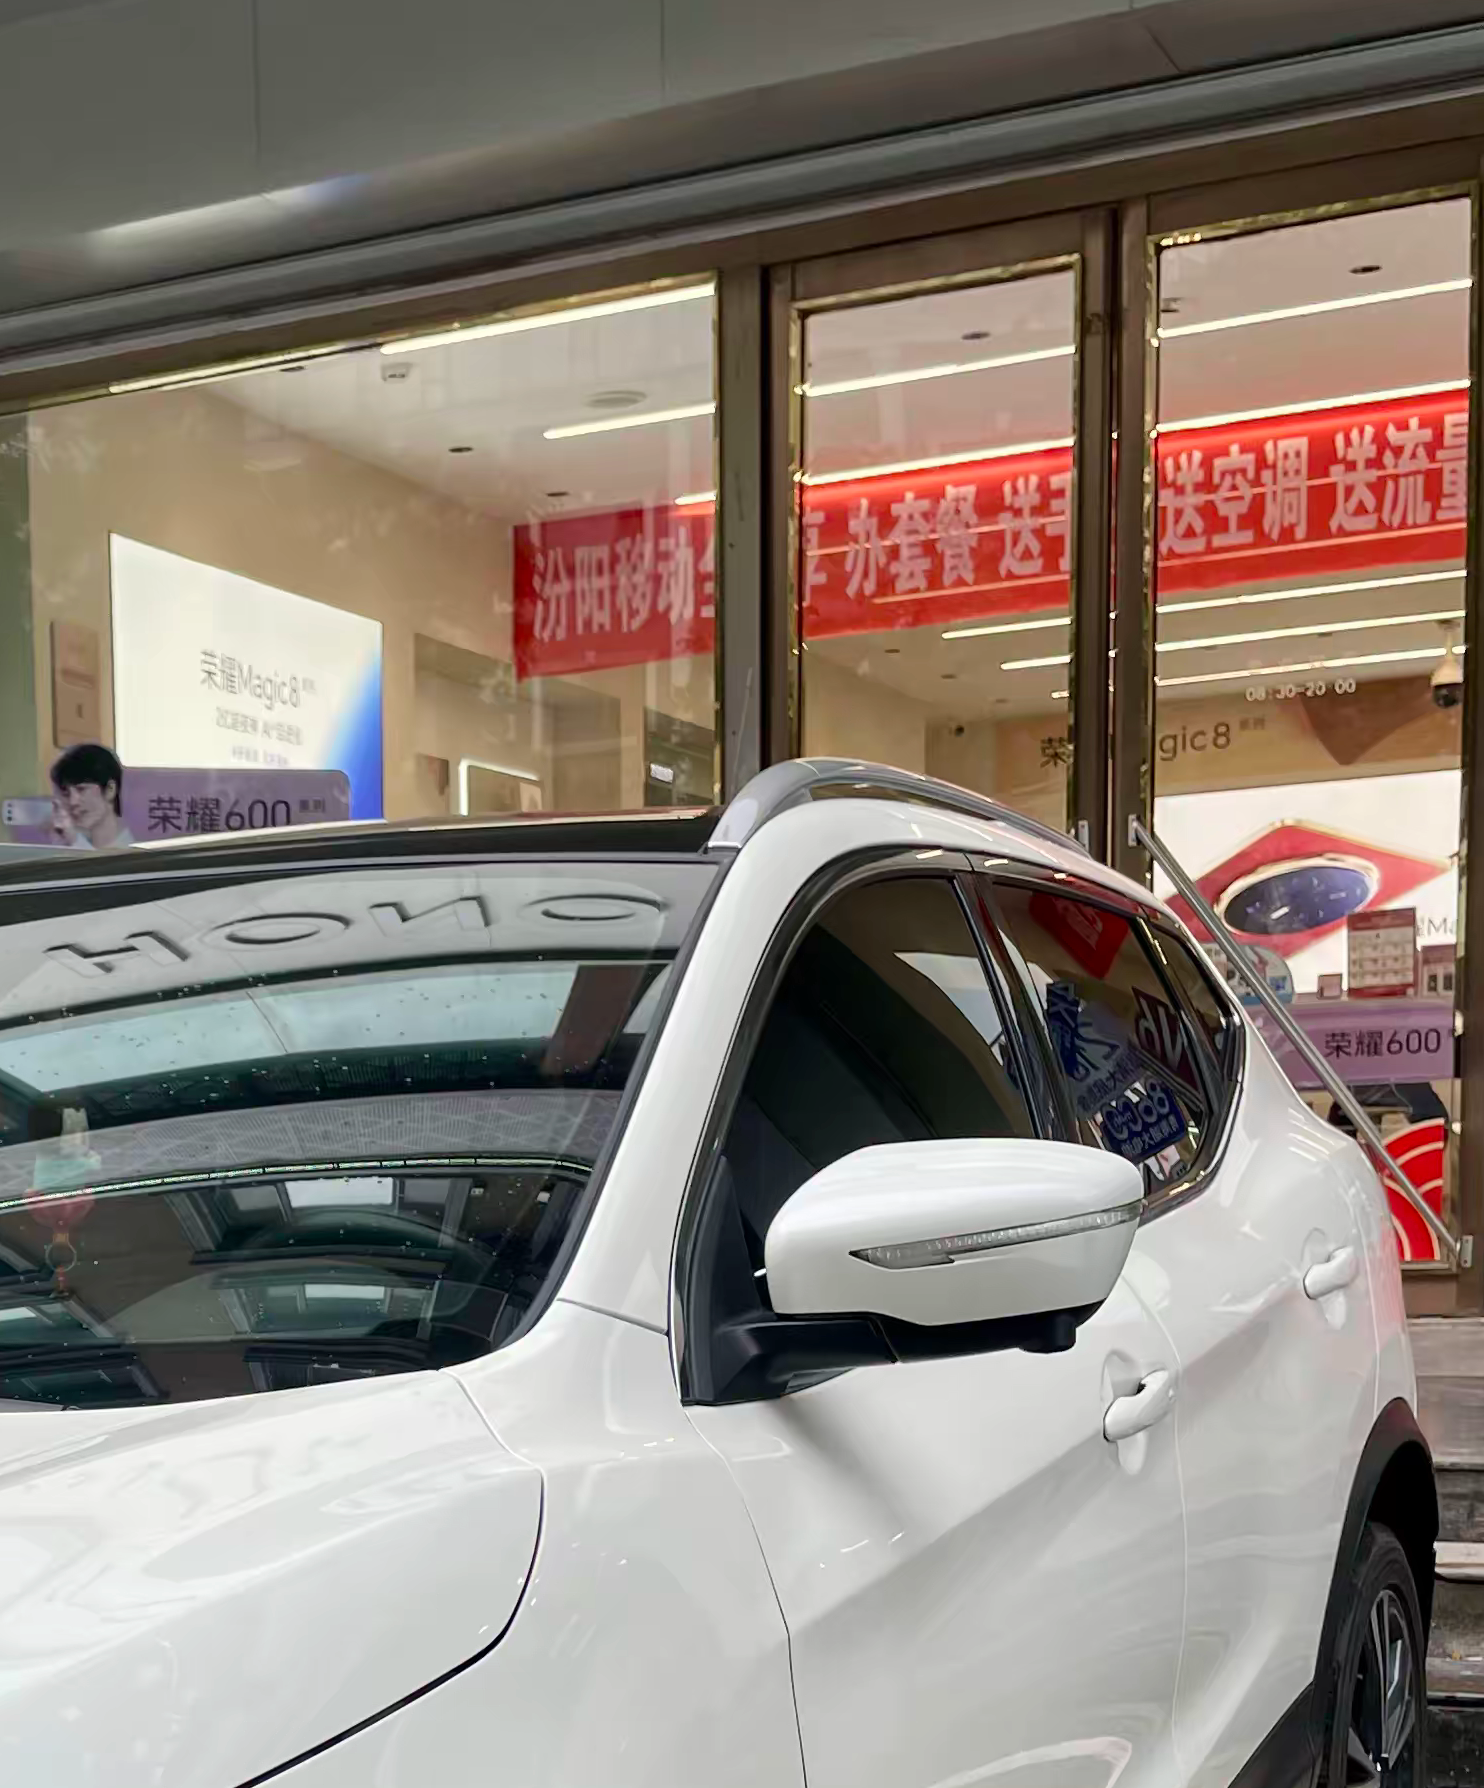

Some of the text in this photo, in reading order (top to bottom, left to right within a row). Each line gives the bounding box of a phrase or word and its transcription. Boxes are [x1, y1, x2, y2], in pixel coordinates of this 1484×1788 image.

[844, 484, 980, 600] 办套餐
[1158, 436, 1309, 556] 送空调
[1328, 411, 1468, 538] 送流量
[147, 796, 291, 834] 荣耀600
[1324, 1028, 1442, 1059] 荣耀600
